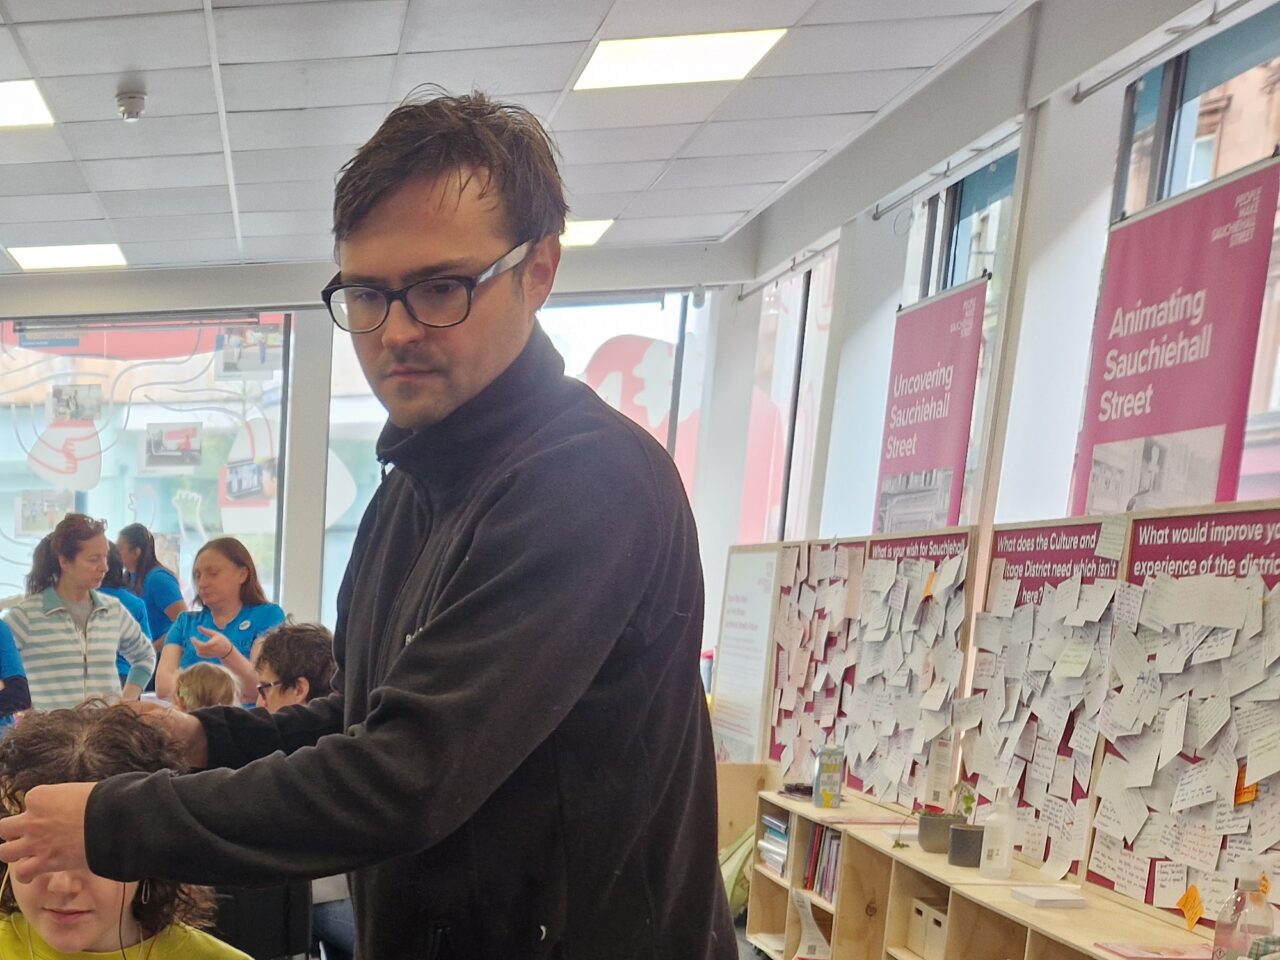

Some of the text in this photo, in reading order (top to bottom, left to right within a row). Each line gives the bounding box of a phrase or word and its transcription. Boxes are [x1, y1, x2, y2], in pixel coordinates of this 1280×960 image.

[1109, 286, 1207, 340] Animating
[1103, 323, 1214, 381] Sauchiehall
[893, 362, 955, 398] Uncovering
[889, 394, 951, 429] Sauchiehall
[1098, 384, 1153, 422] Street
[886, 434, 917, 460] Street
[997, 531, 1096, 552] What does the Culture and
[1138, 524, 1169, 546] What
[1172, 521, 1209, 543] would
[1210, 520, 1263, 546] improve
[872, 541, 886, 557] What
[887, 541, 893, 556] is
[892, 543, 906, 558] your
[906, 540, 919, 556] wish
[919, 539, 929, 556] for
[1024, 559, 1050, 577] District
[1050, 558, 1071, 576] need
[1073, 557, 1097, 577] which
[1098, 558, 1117, 577] isn't
[1133, 554, 1197, 577] experience
[1199, 553, 1214, 575] of
[1214, 554, 1236, 575] the
[1021, 586, 1044, 604] here?
